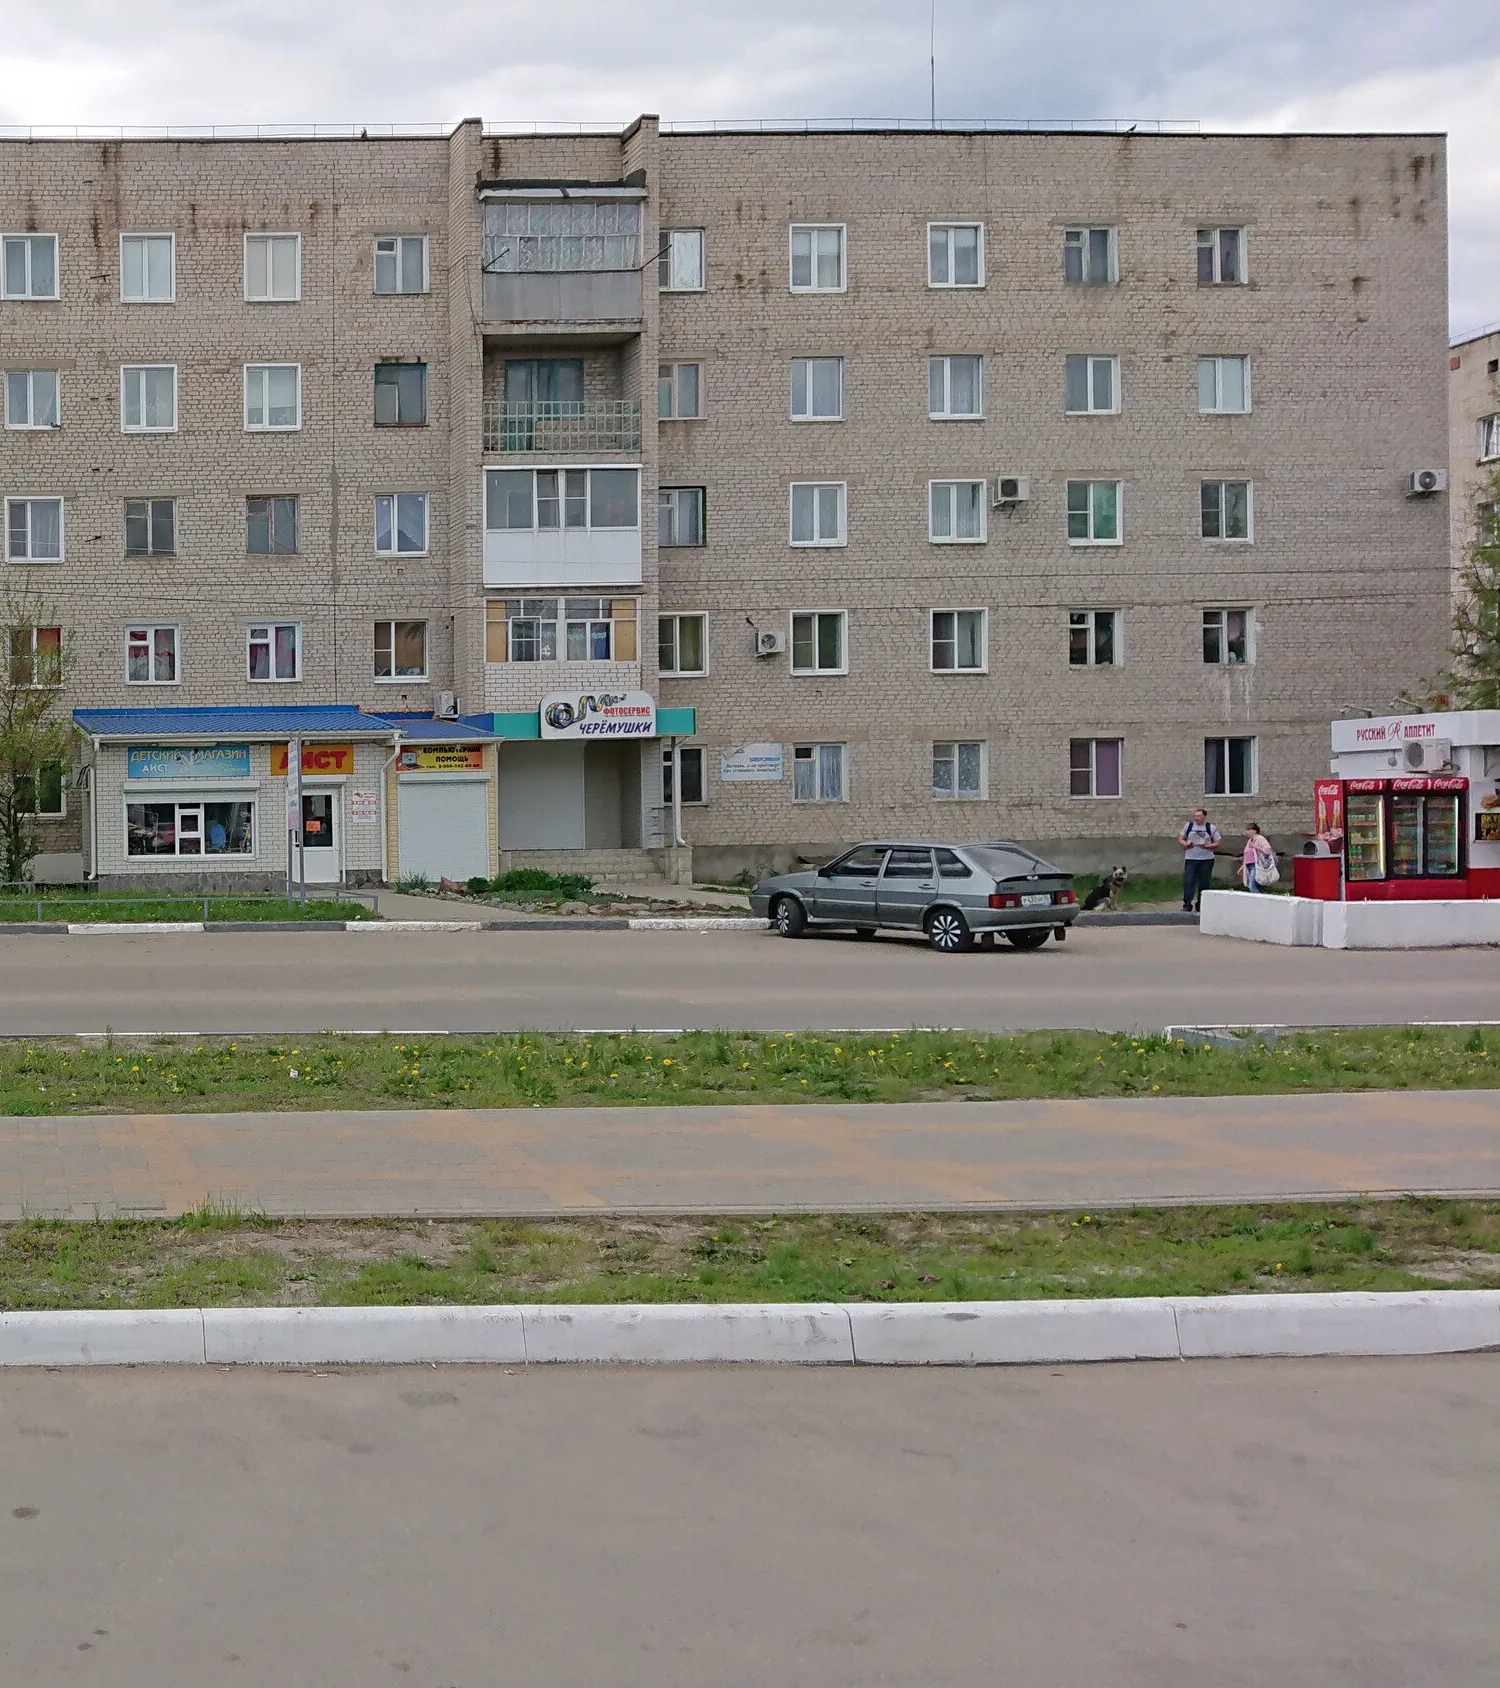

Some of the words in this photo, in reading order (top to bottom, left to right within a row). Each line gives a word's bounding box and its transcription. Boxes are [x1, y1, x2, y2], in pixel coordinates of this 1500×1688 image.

[602, 706, 651, 715] ФОТОСЕРВИС
[579, 720, 653, 734] ЧЕРЁМУШКИ
[1356, 725, 1386, 742] РУССКИЙ
[1404, 723, 1436, 739] АППЕТИТ
[131, 749, 181, 763] ДЕТСКИЙ
[197, 749, 247, 760] МАГАЗИН
[142, 764, 168, 773] АИСТ
